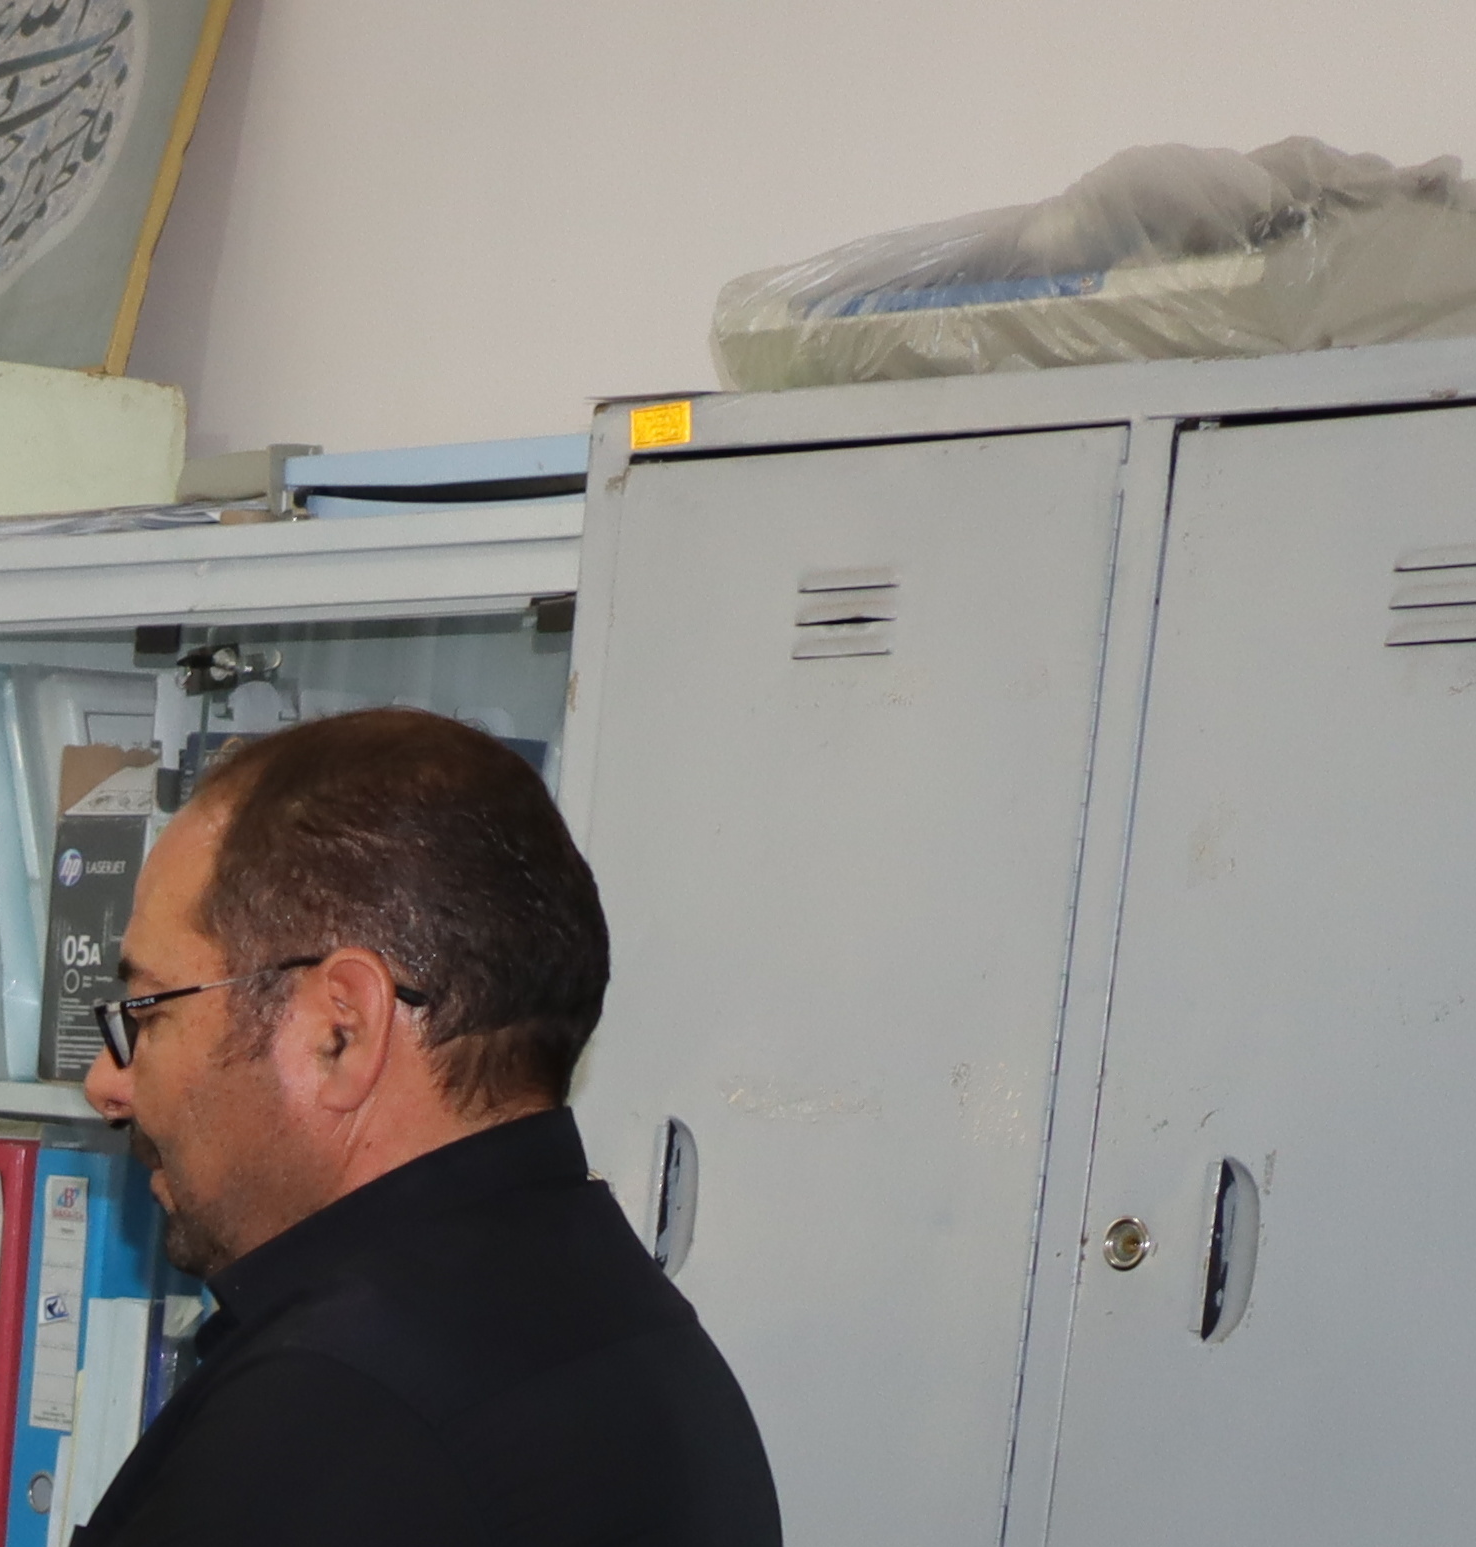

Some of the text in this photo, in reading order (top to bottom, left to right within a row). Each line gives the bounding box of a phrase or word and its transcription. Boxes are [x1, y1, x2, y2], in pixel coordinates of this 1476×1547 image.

[85, 861, 126, 874] LASERJET
[62, 935, 101, 966] 05A
[125, 997, 155, 1008] POLICE
